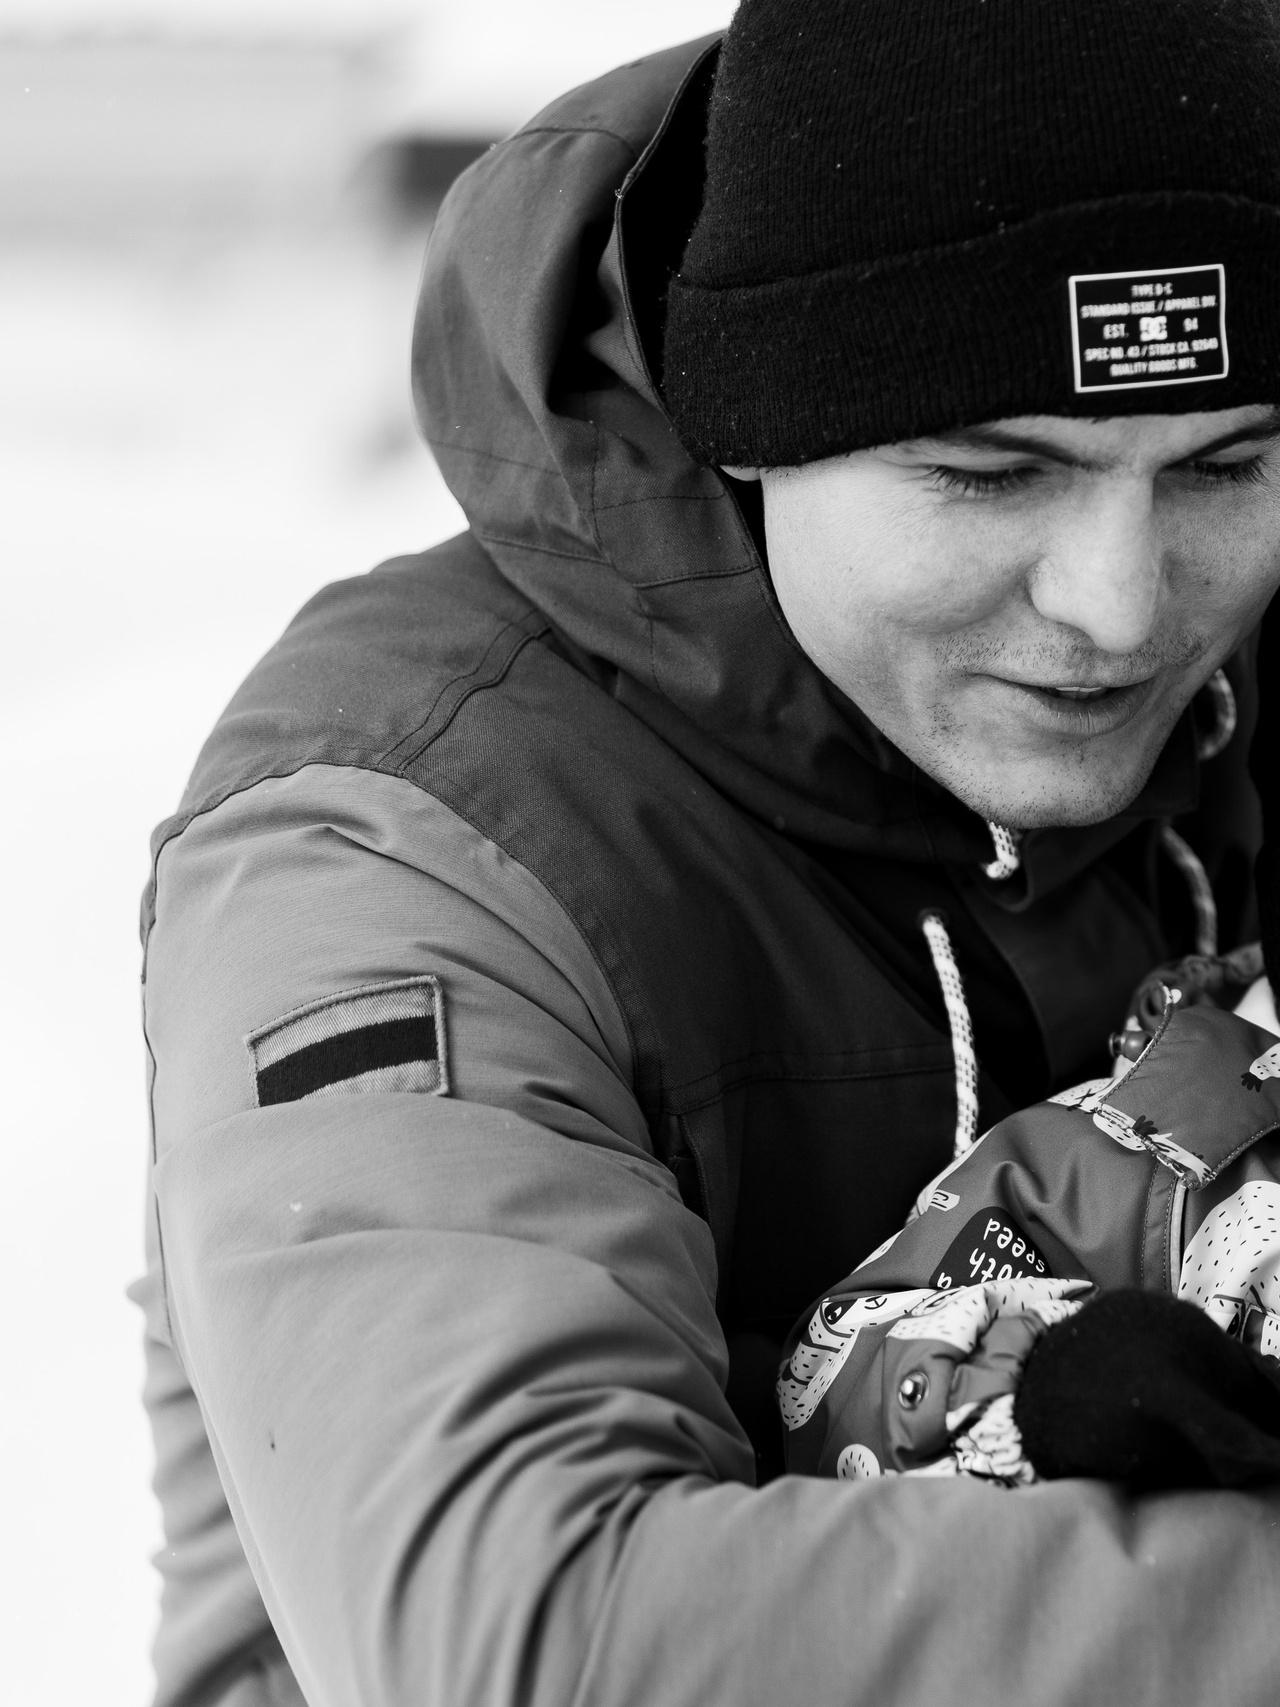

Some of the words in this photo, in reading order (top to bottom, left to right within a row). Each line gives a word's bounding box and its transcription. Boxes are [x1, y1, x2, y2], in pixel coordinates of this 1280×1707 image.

[1131, 284, 1154, 297] TYPE
[1080, 303, 1130, 318] STANDARD
[1130, 301, 1156, 315] ISSUE
[1164, 297, 1200, 312] APPAREL
[1110, 362, 1147, 377] QUALITY
[1148, 359, 1177, 373] GOODS
[983, 1218, 1045, 1273] speed
